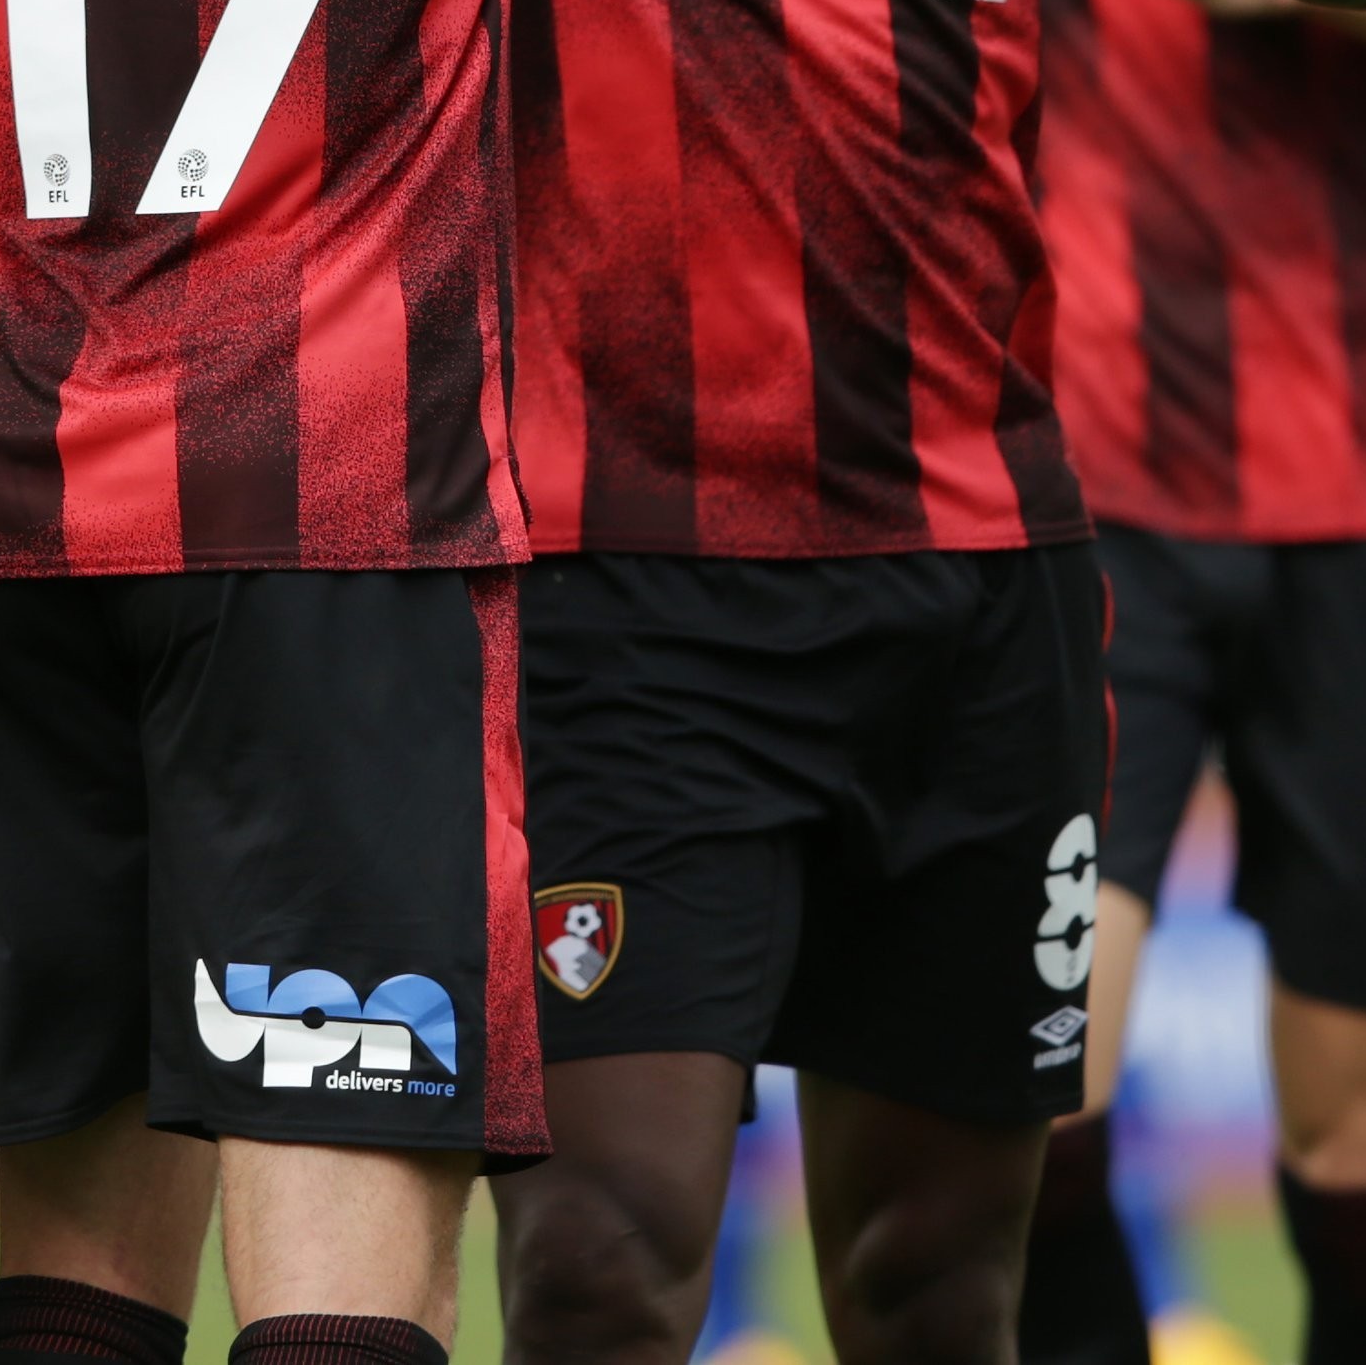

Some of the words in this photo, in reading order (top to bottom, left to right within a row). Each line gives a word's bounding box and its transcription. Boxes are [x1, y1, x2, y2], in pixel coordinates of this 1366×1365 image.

[48, 190, 69, 203] EFL
[181, 185, 205, 198] EFL
[1033, 813, 1097, 991] 8
[325, 1070, 403, 1094] delivers
[407, 1079, 456, 1098] more
